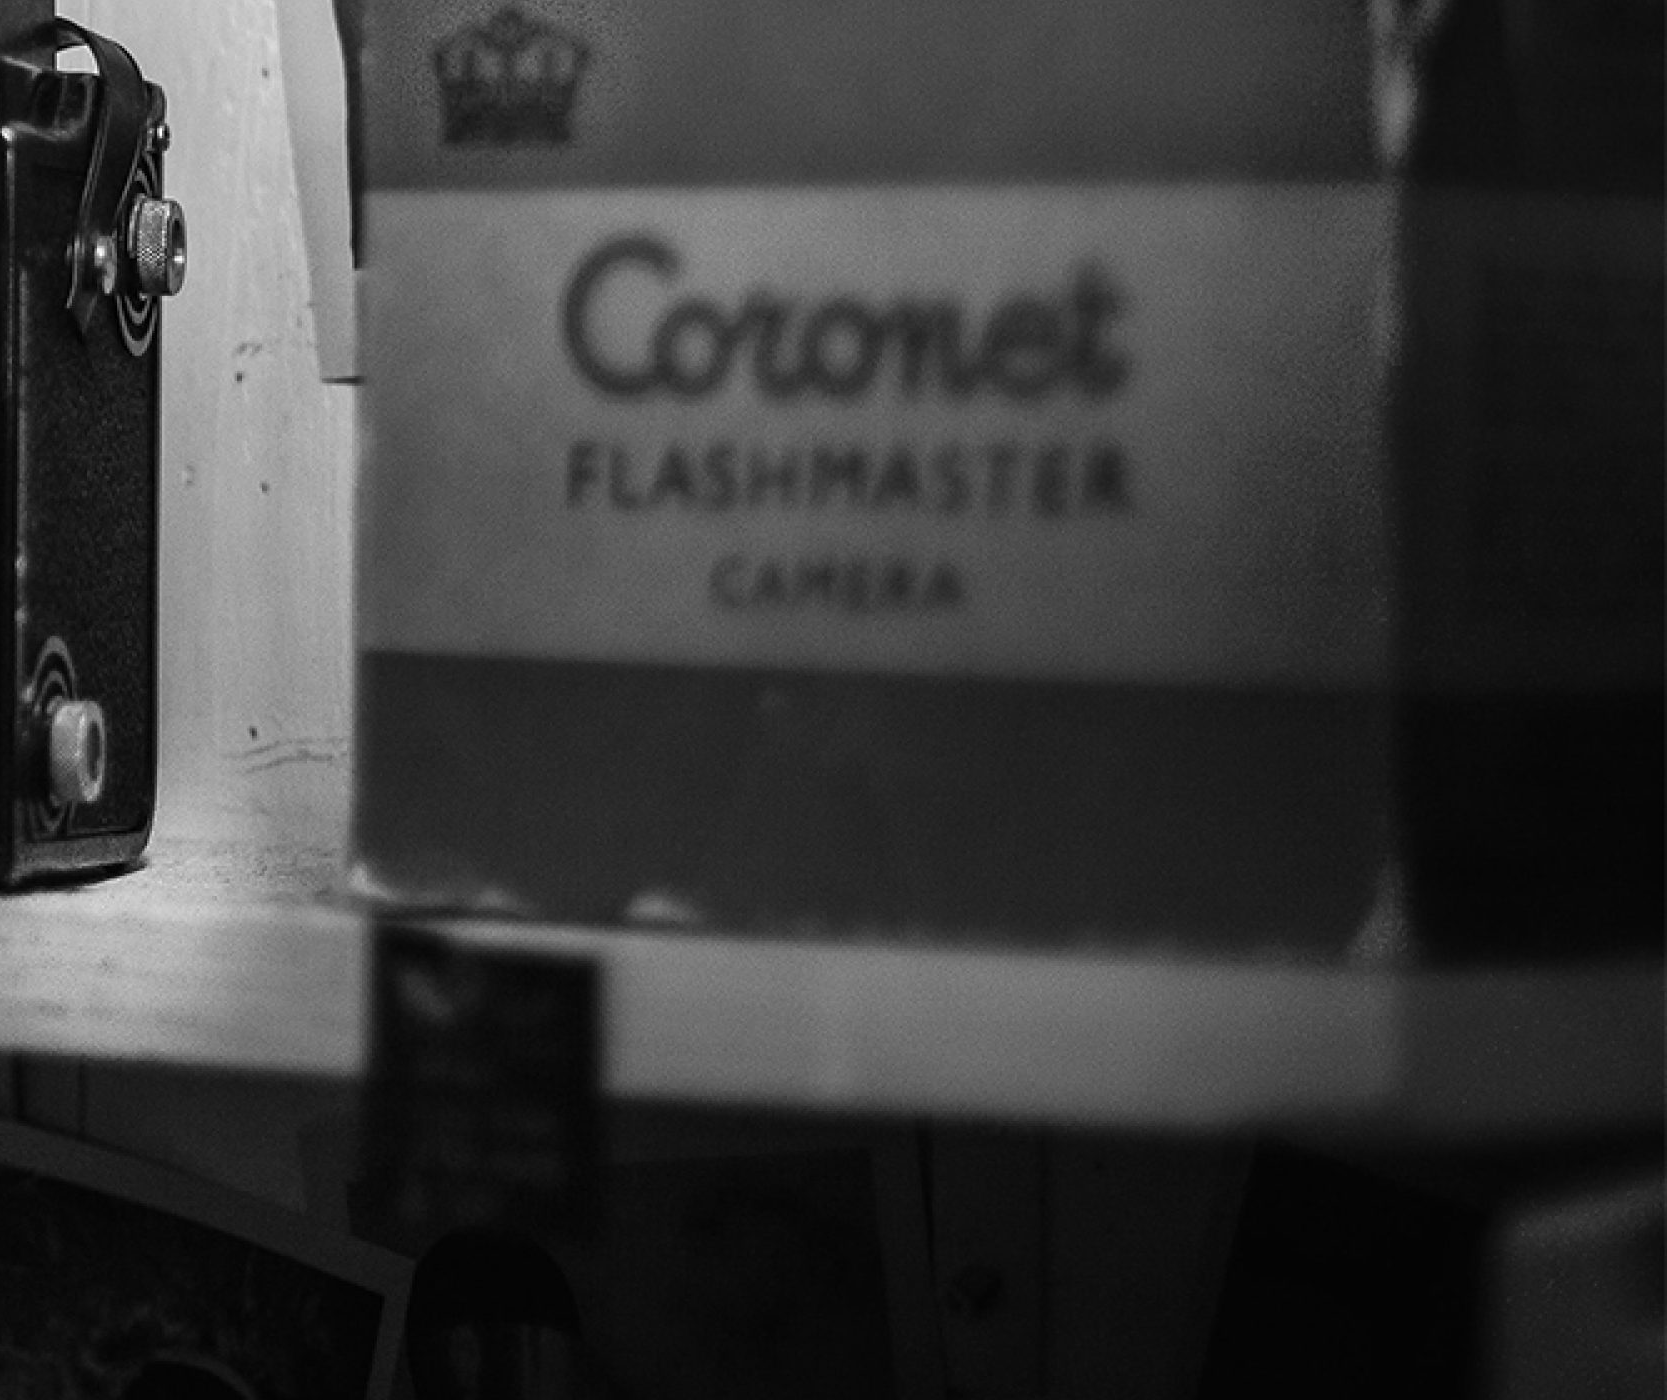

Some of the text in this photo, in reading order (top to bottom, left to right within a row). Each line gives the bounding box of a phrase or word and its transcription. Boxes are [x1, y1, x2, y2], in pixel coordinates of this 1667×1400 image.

[561, 232, 1135, 402] Coronet
[563, 439, 1135, 518] FLASHMASTER
[708, 553, 966, 612] CAMERA
